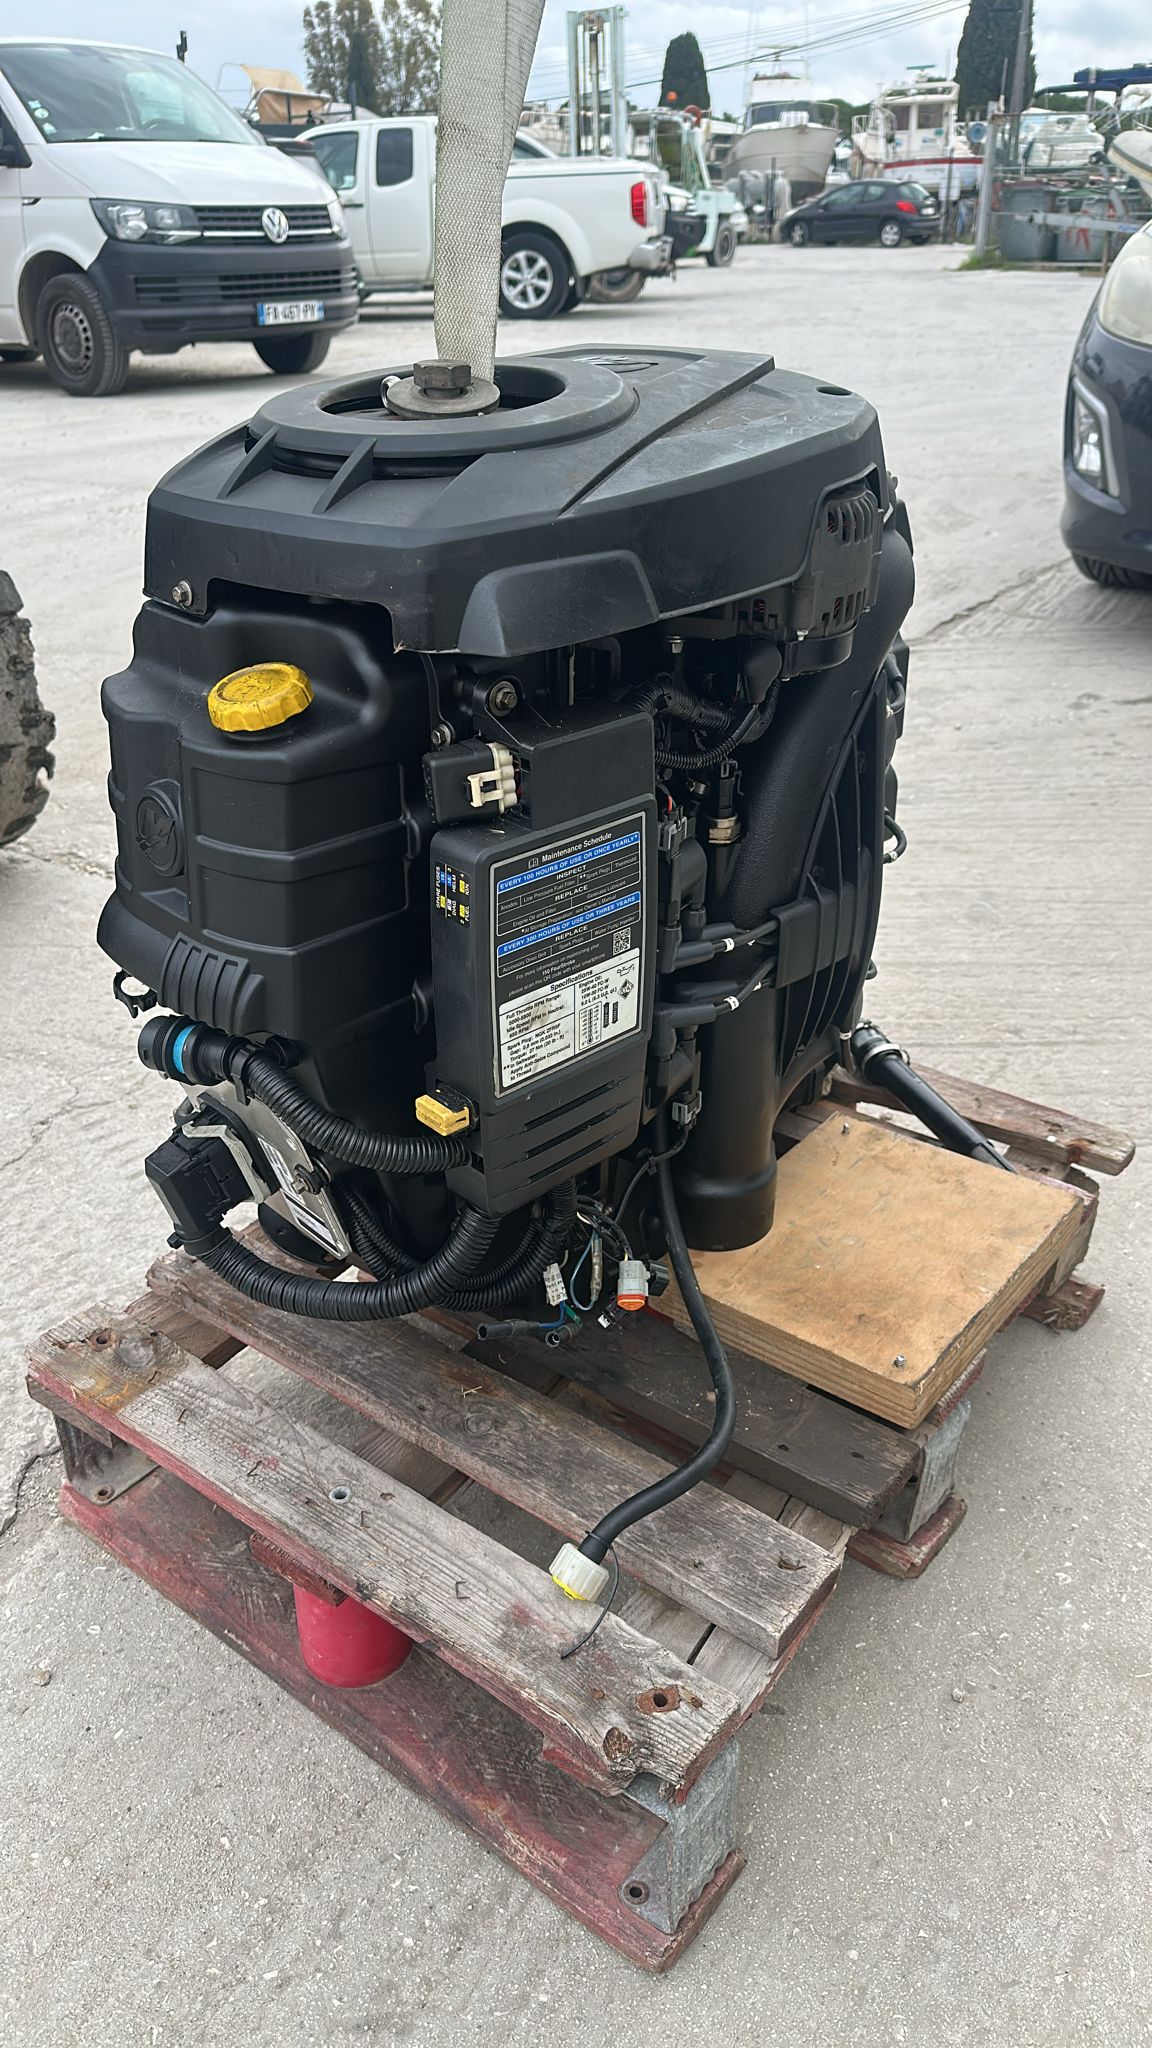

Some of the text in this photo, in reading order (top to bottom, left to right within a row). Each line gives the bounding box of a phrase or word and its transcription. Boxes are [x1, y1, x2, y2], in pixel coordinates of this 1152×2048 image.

[542, 833, 611, 862] Maintenance Schedule
[500, 877, 521, 889] EVERY
[523, 873, 534, 881] 100
[535, 864, 558, 876] HOURS
[559, 860, 568, 868] OF
[569, 855, 582, 864] USE
[583, 851, 592, 859] OR
[593, 845, 610, 855] ONCE
[615, 856, 637, 867] Thermostat
[556, 864, 586, 880] INSPECT
[533, 888, 553, 898] Pressure
[554, 883, 563, 891] Fuel
[555, 884, 588, 901] REPLACE
[586, 888, 606, 899] Gearcase
[500, 902, 517, 911] Anodes
[503, 939, 524, 951] EVERY
[526, 934, 536, 943] 300
[538, 925, 560, 938] HOURS
[561, 921, 570, 929] OF
[571, 916, 583, 925] USE
[595, 904, 614, 915] THREE
[616, 896, 635, 907] YEARS
[512, 918, 528, 927] Engine
[530, 921, 547, 931] Storage
[555, 925, 587, 941] REPLACE
[559, 941, 571, 950] Spark
[502, 961, 524, 972] Accessory
[550, 970, 592, 991] Specifications
[578, 979, 594, 989] Engine
[506, 1012, 515, 1020] Full
[515, 1005, 533, 1015] Throttle
[534, 999, 545, 1007] RPM
[516, 1019, 530, 1029] Speed
[530, 1014, 541, 1022] RPM
[518, 1026, 529, 1034] RPM
[507, 1042, 520, 1051] Spark
[510, 1066, 523, 1075] Apply
[546, 1043, 570, 1058] Compound
[516, 1067, 531, 1078] Thread
